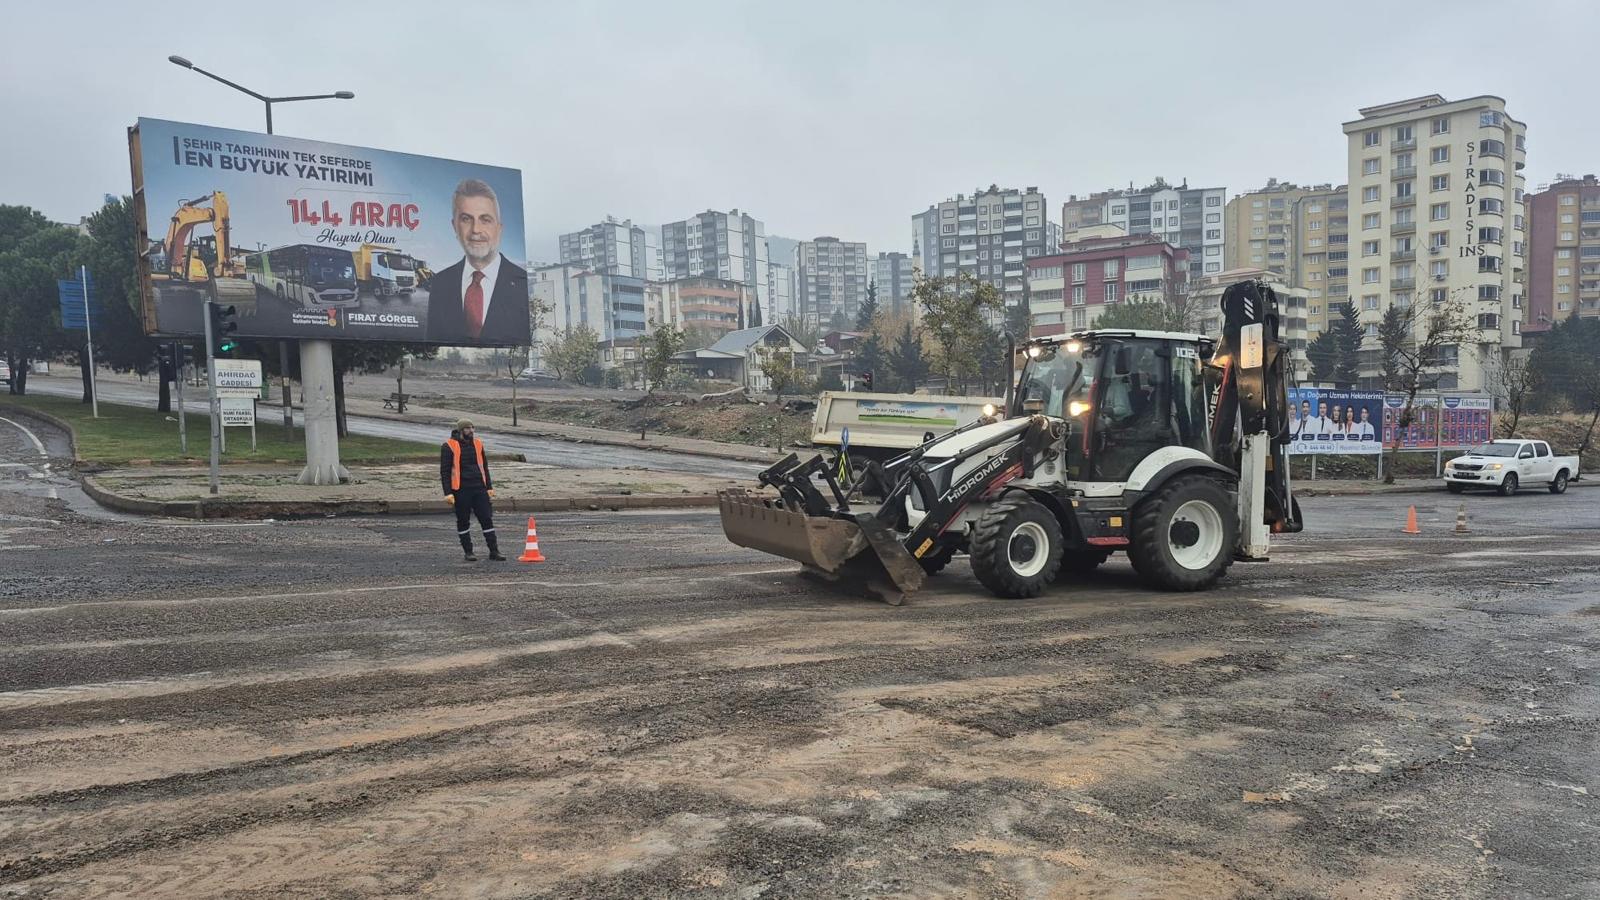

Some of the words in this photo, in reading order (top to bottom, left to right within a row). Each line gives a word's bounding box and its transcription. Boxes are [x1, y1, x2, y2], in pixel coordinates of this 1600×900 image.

[185, 151, 213, 168] EN
[220, 154, 289, 177] BÜYÜK
[295, 164, 374, 187] YATIRIMI
[293, 151, 317, 163] TEK
[319, 155, 372, 170] SEFERDE
[287, 199, 343, 227] 144
[350, 201, 420, 231] ARAÇ
[316, 228, 363, 247] Hayırlı
[364, 230, 397, 244] Olsun
[348, 313, 377, 322] FIRAT
[379, 314, 419, 324] GÖRGEL
